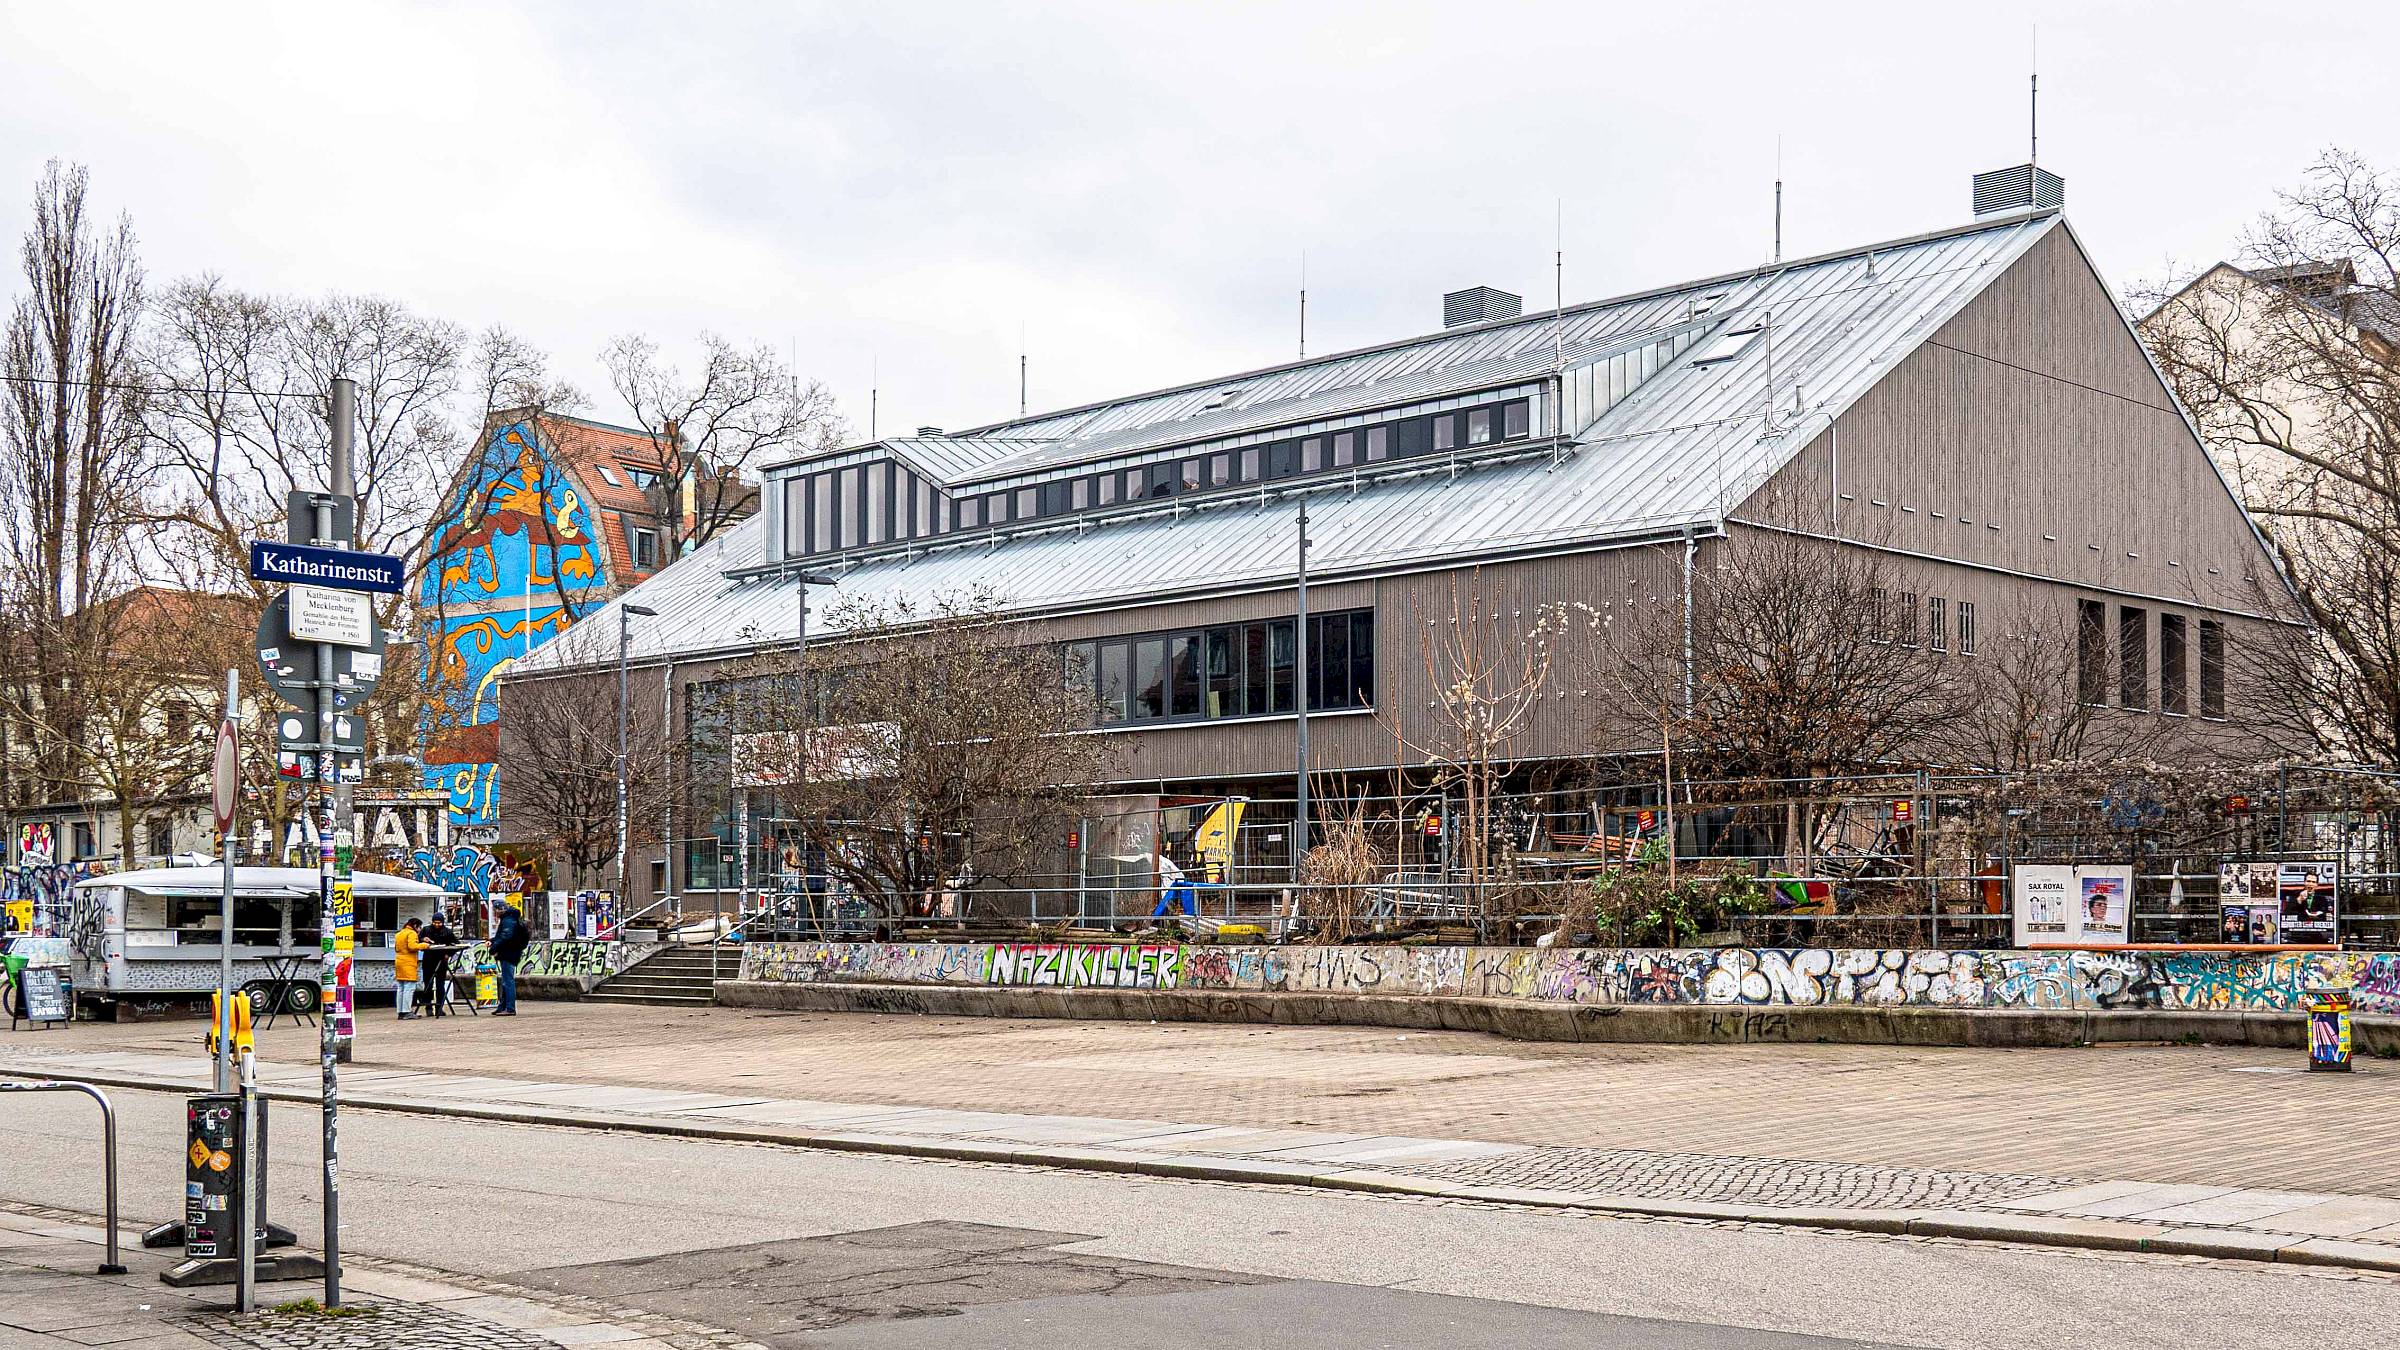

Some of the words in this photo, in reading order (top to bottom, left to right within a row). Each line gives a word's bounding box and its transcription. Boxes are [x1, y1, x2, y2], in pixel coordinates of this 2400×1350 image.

[261, 551, 395, 585] Katharinenstr.
[306, 590, 341, 602] Katharina
[308, 601, 355, 614] Mecklenburg
[990, 943, 1180, 990] NAZIKILLER
[32, 1007, 65, 1017] SAMOSA
